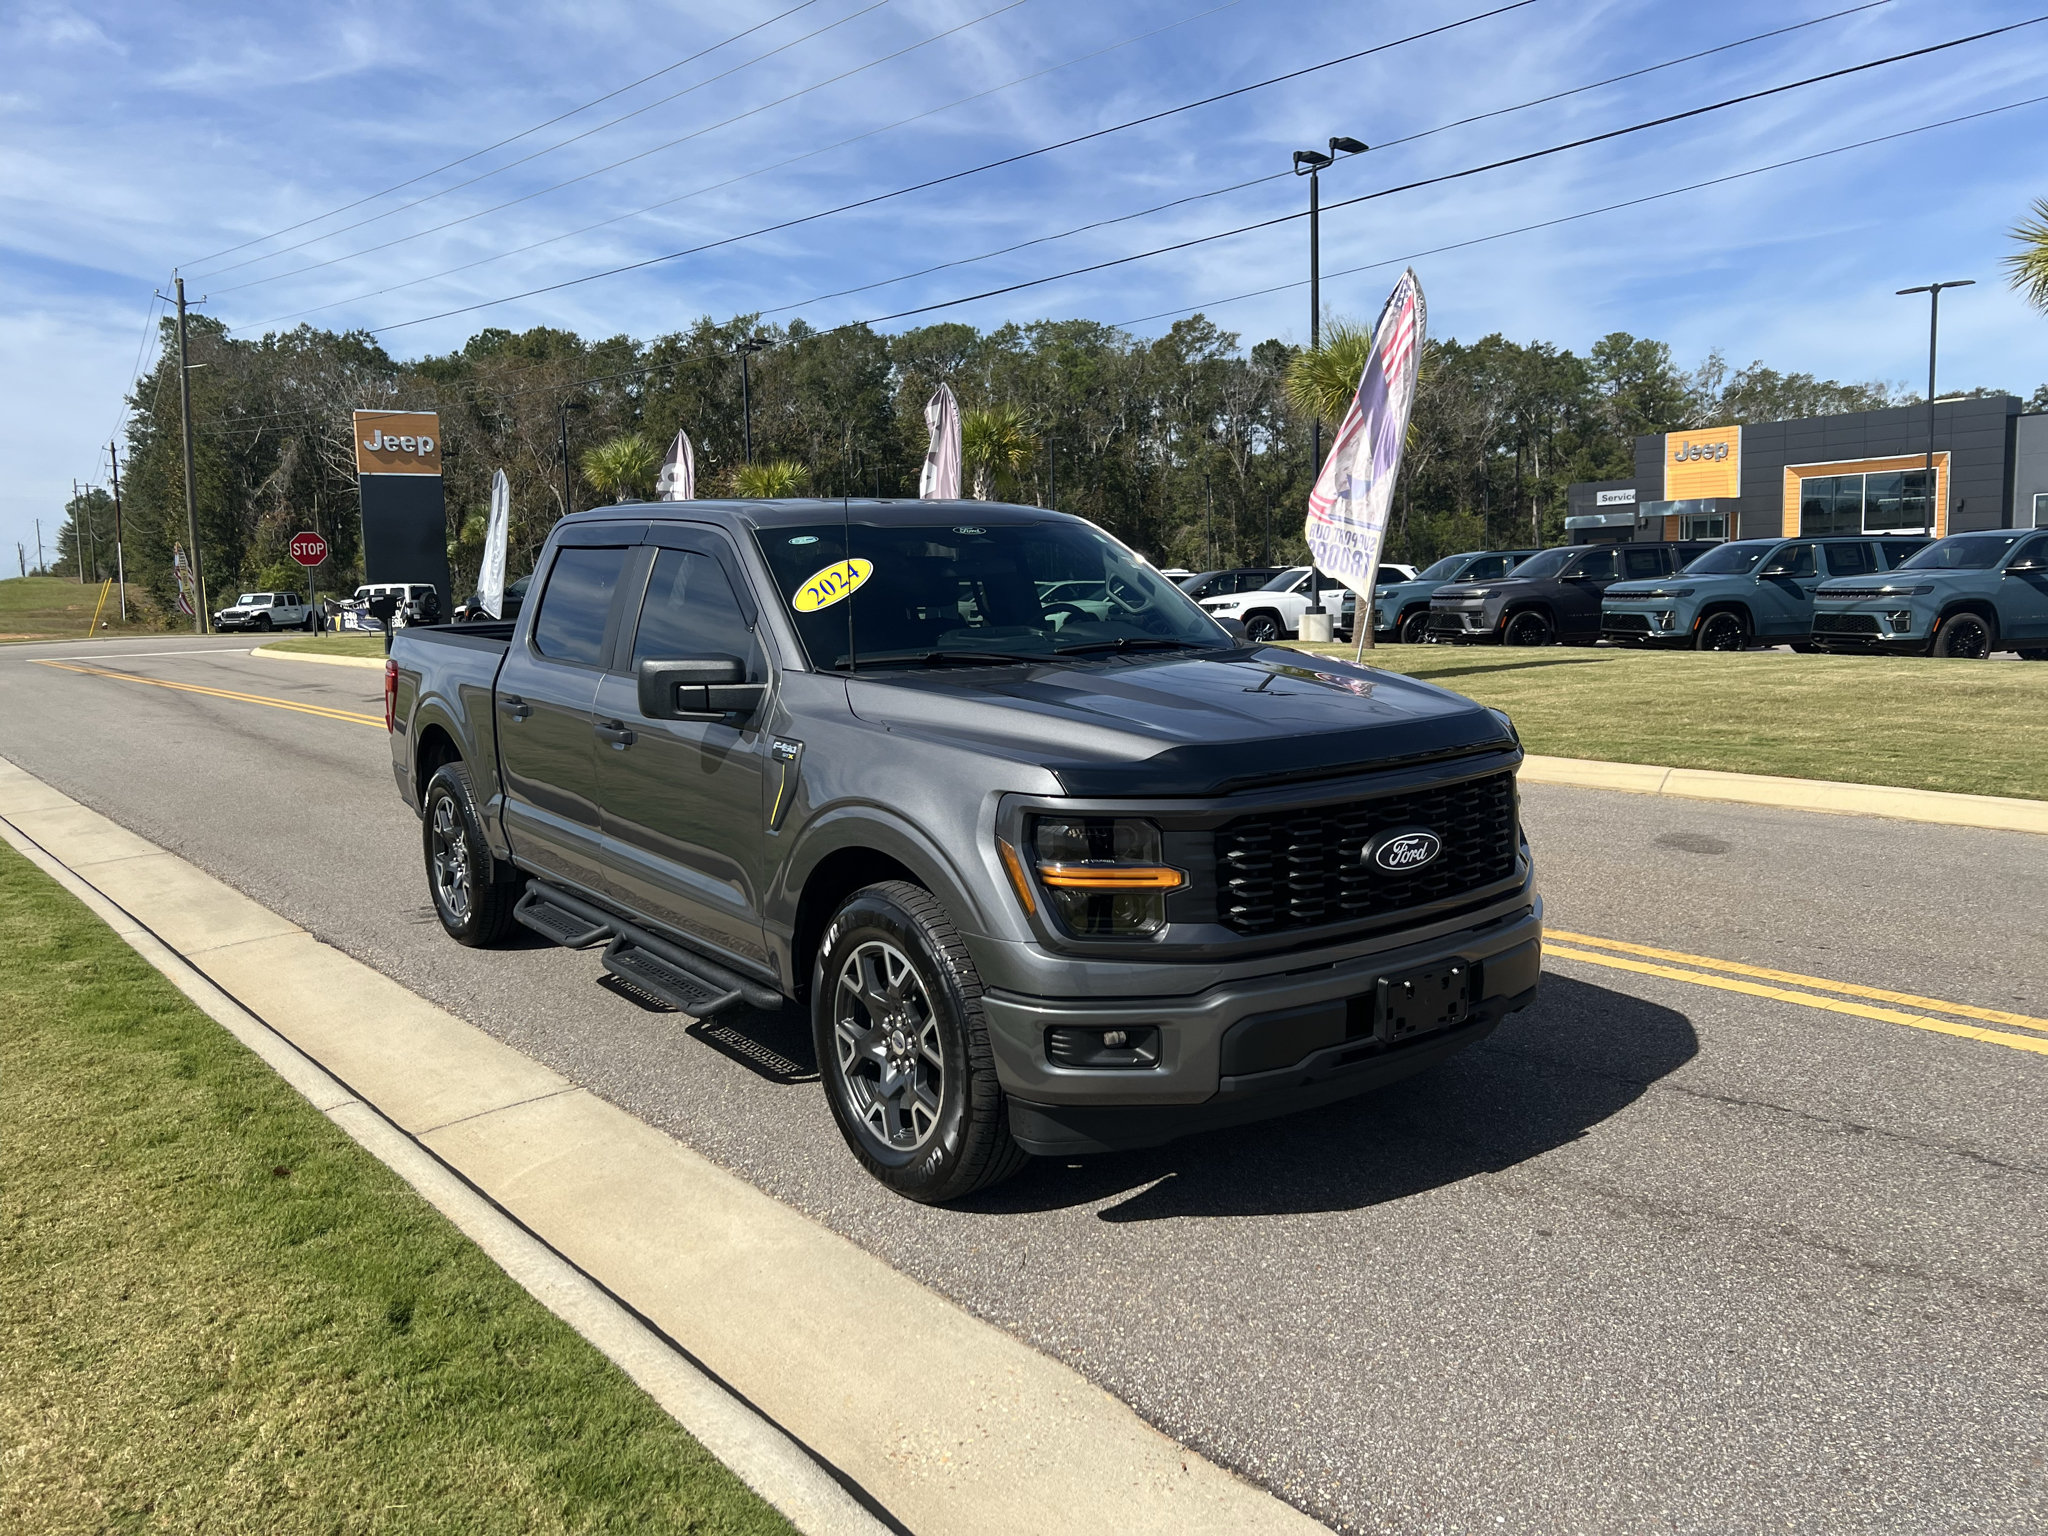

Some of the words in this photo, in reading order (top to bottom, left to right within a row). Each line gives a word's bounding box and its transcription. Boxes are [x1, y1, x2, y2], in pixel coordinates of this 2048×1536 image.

[363, 429, 435, 456] Jeep
[1674, 441, 1729, 462] Jeep
[293, 542, 325, 556] STOP
[807, 563, 861, 606] 2024
[1389, 838, 1429, 866] Ford
